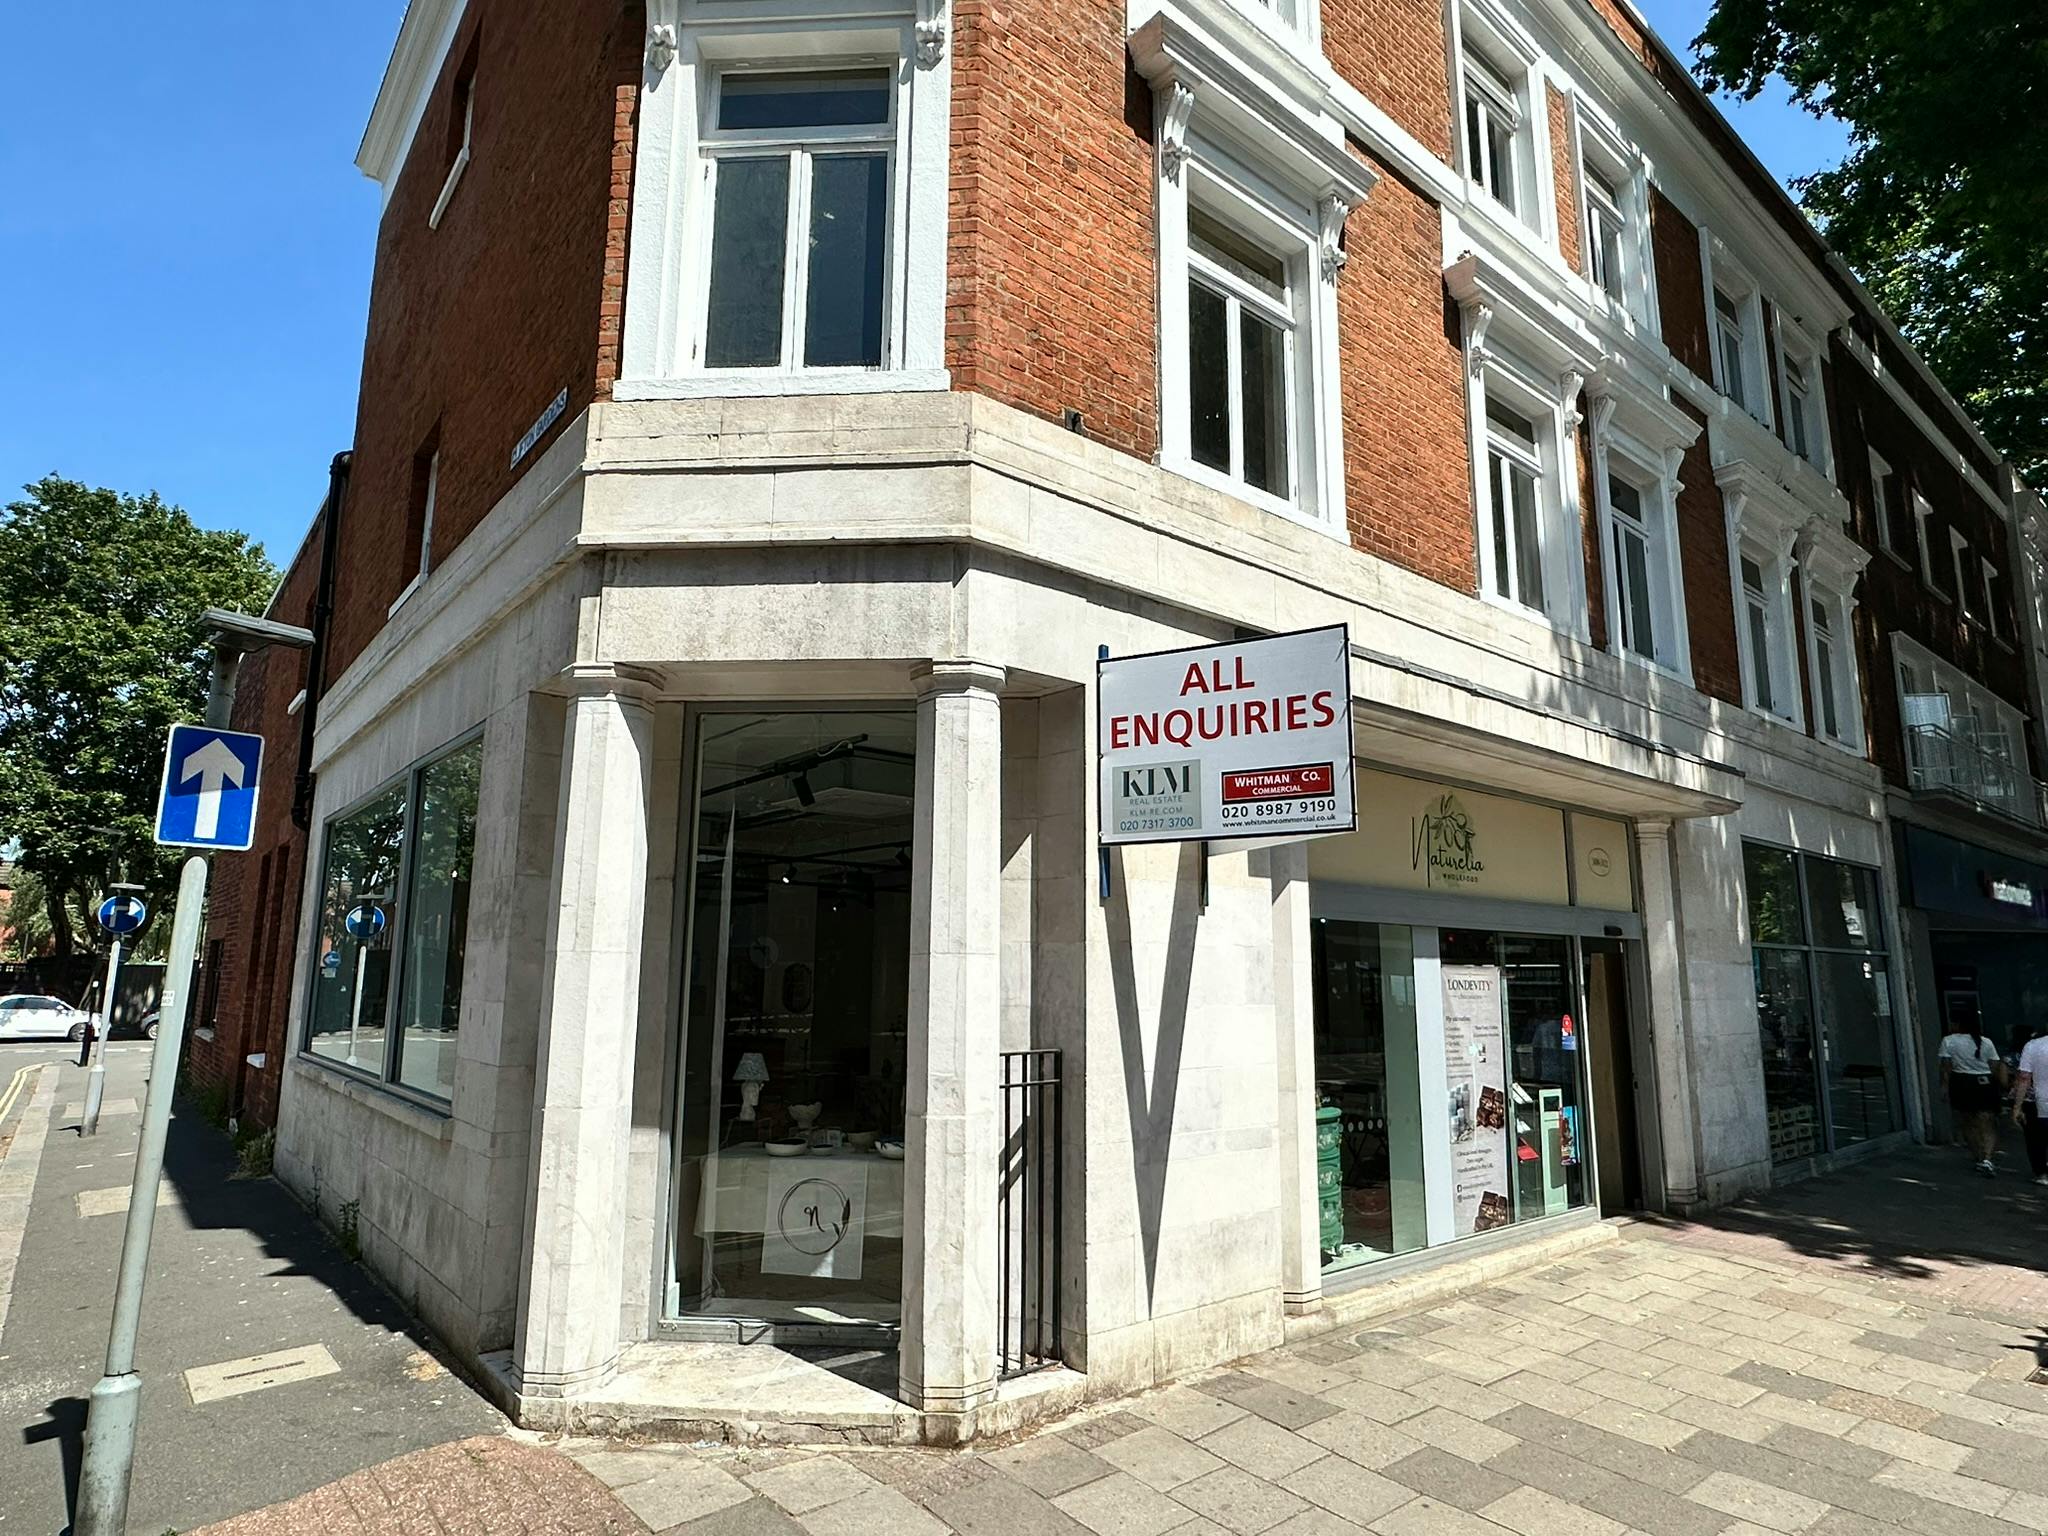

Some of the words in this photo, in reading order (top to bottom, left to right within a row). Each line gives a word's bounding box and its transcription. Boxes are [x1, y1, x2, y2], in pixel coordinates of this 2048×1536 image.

[1179, 656, 1255, 697] ALL
[1110, 691, 1335, 749] ENQUIRIES
[1120, 765, 1191, 797] KLM
[1234, 774, 1290, 787] WHITMAN
[1252, 785, 1302, 796] COMMERCIAL
[1129, 798, 1150, 806] REAL
[1153, 795, 1182, 804] ESTATE
[1222, 805, 1249, 818] 020
[1255, 802, 1293, 816] 8987
[1299, 799, 1336, 813] 9190
[1120, 820, 1139, 831] 020
[1142, 818, 1164, 830] 7317
[1168, 816, 1194, 828] 3700
[1222, 813, 1336, 828] www.whitmancommercial.co.uk
[1447, 979, 1491, 991] LONDEVITY
